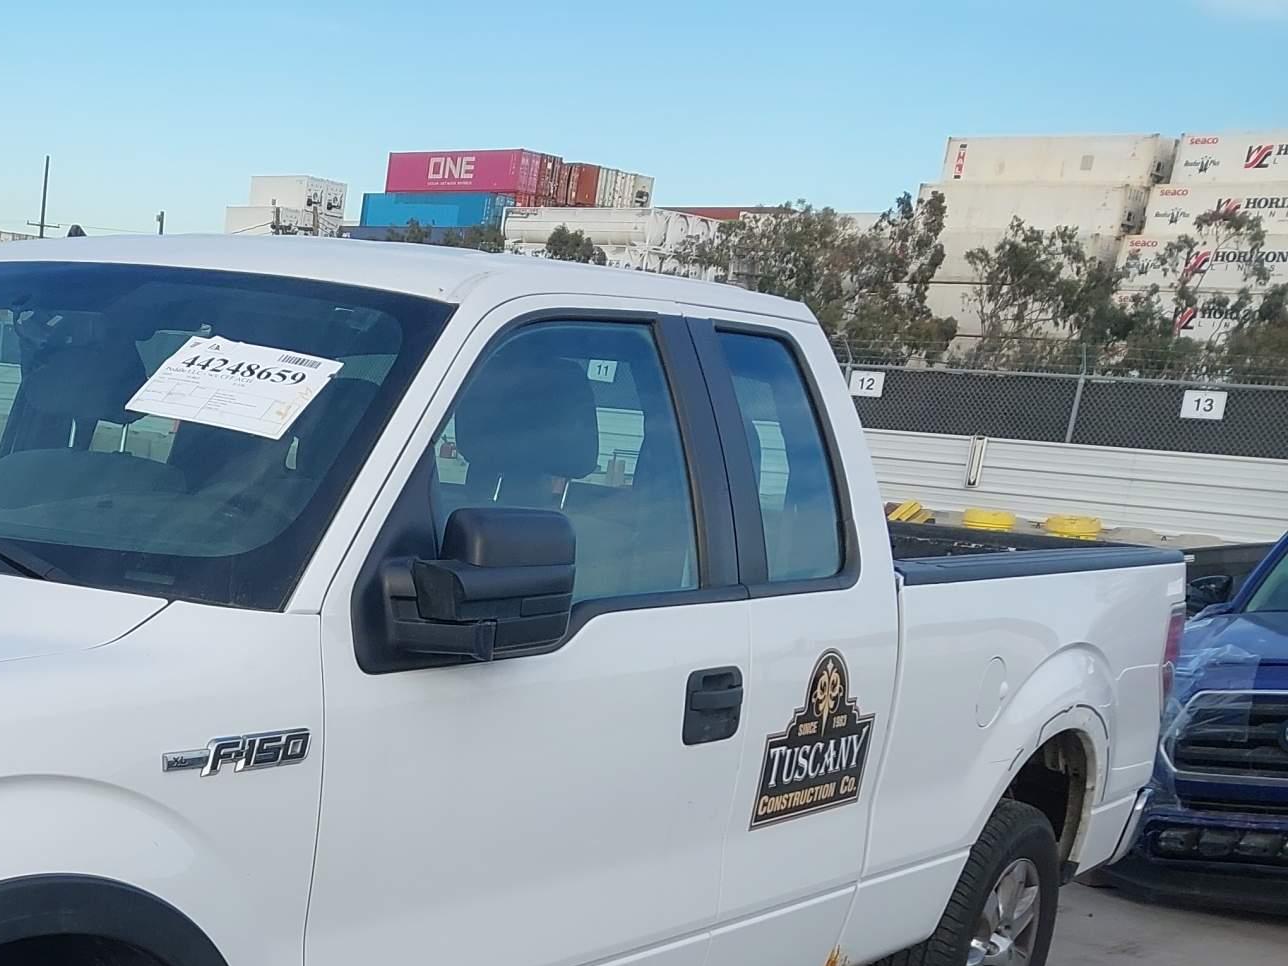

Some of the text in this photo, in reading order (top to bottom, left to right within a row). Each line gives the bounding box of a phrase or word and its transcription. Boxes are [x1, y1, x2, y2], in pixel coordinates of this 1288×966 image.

[1189, 136, 1219, 145] seaco
[427, 156, 475, 179] ONE
[1160, 188, 1189, 197] seaco
[1129, 239, 1158, 248] seaco
[181, 354, 307, 386] 44248659
[596, 364, 609, 377] 11
[858, 377, 875, 391] 12
[1193, 397, 1214, 412] 13
[768, 725, 870, 788] TUSCANY
[757, 781, 837, 816] CONSTRUCTION
